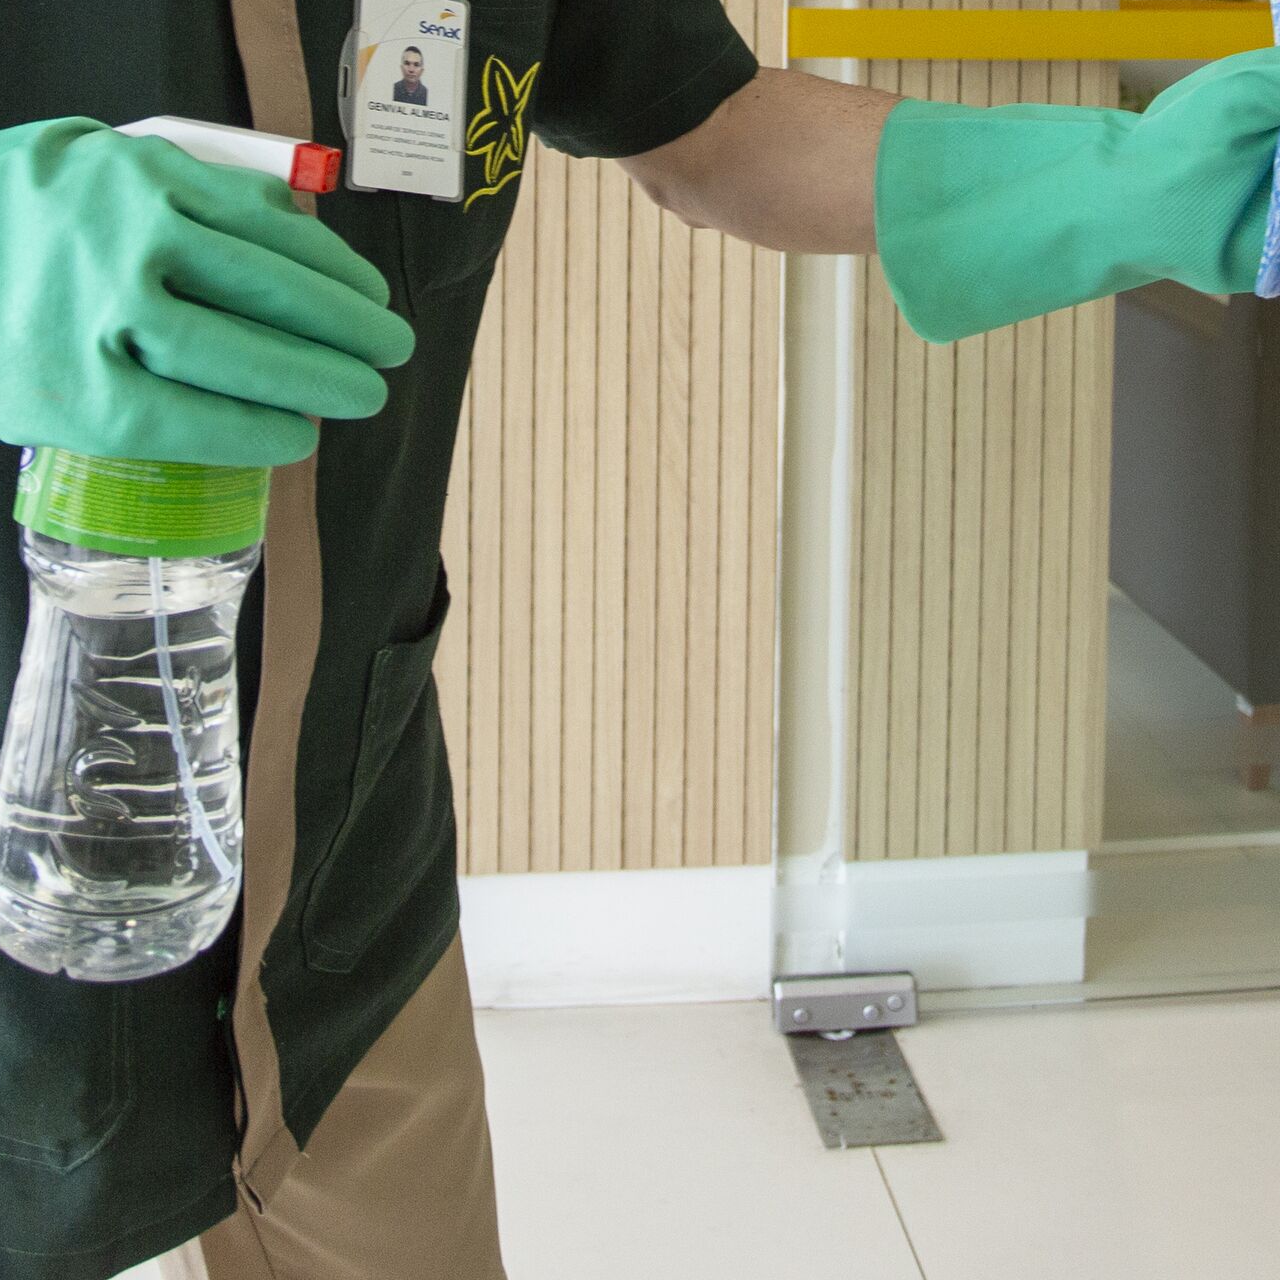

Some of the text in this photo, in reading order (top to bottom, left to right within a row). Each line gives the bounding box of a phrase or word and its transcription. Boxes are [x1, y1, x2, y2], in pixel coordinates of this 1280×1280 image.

[419, 20, 461, 40] Senac
[368, 101, 450, 121] GENIVAL ALMEIDA
